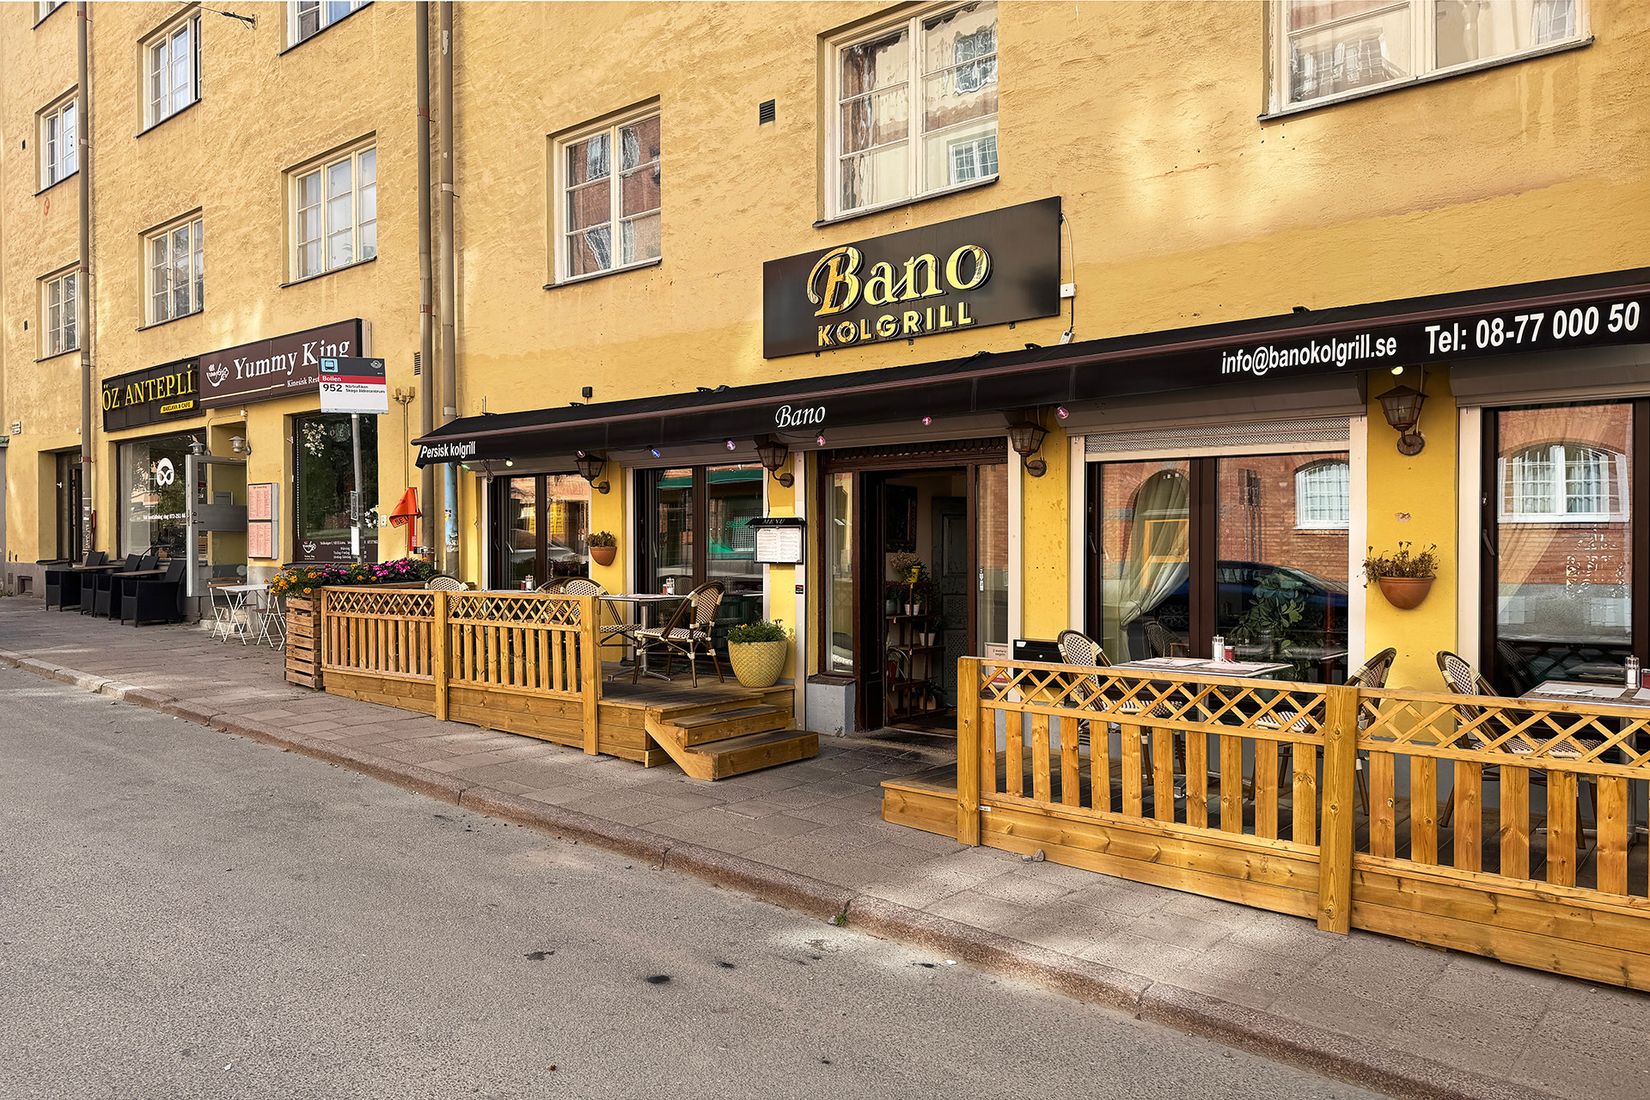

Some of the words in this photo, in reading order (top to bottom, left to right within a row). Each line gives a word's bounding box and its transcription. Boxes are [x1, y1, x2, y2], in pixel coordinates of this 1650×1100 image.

[807, 245, 992, 317] Bano
[817, 301, 977, 347] KOLGRILL
[1424, 323, 1468, 355] Tel:
[1475, 313, 1545, 349] 08-77
[1552, 306, 1600, 340] 000
[1607, 301, 1641, 332] 50
[234, 351, 298, 380] Yummy
[301, 339, 350, 367] King
[1221, 334, 1397, 376] info@banokolgrill.se
[102, 383, 120, 411] ÖZ
[322, 383, 343, 393] 952
[775, 404, 826, 428] Bano
[420, 443, 449, 459] Persisk
[450, 440, 476, 459] kolgrill
